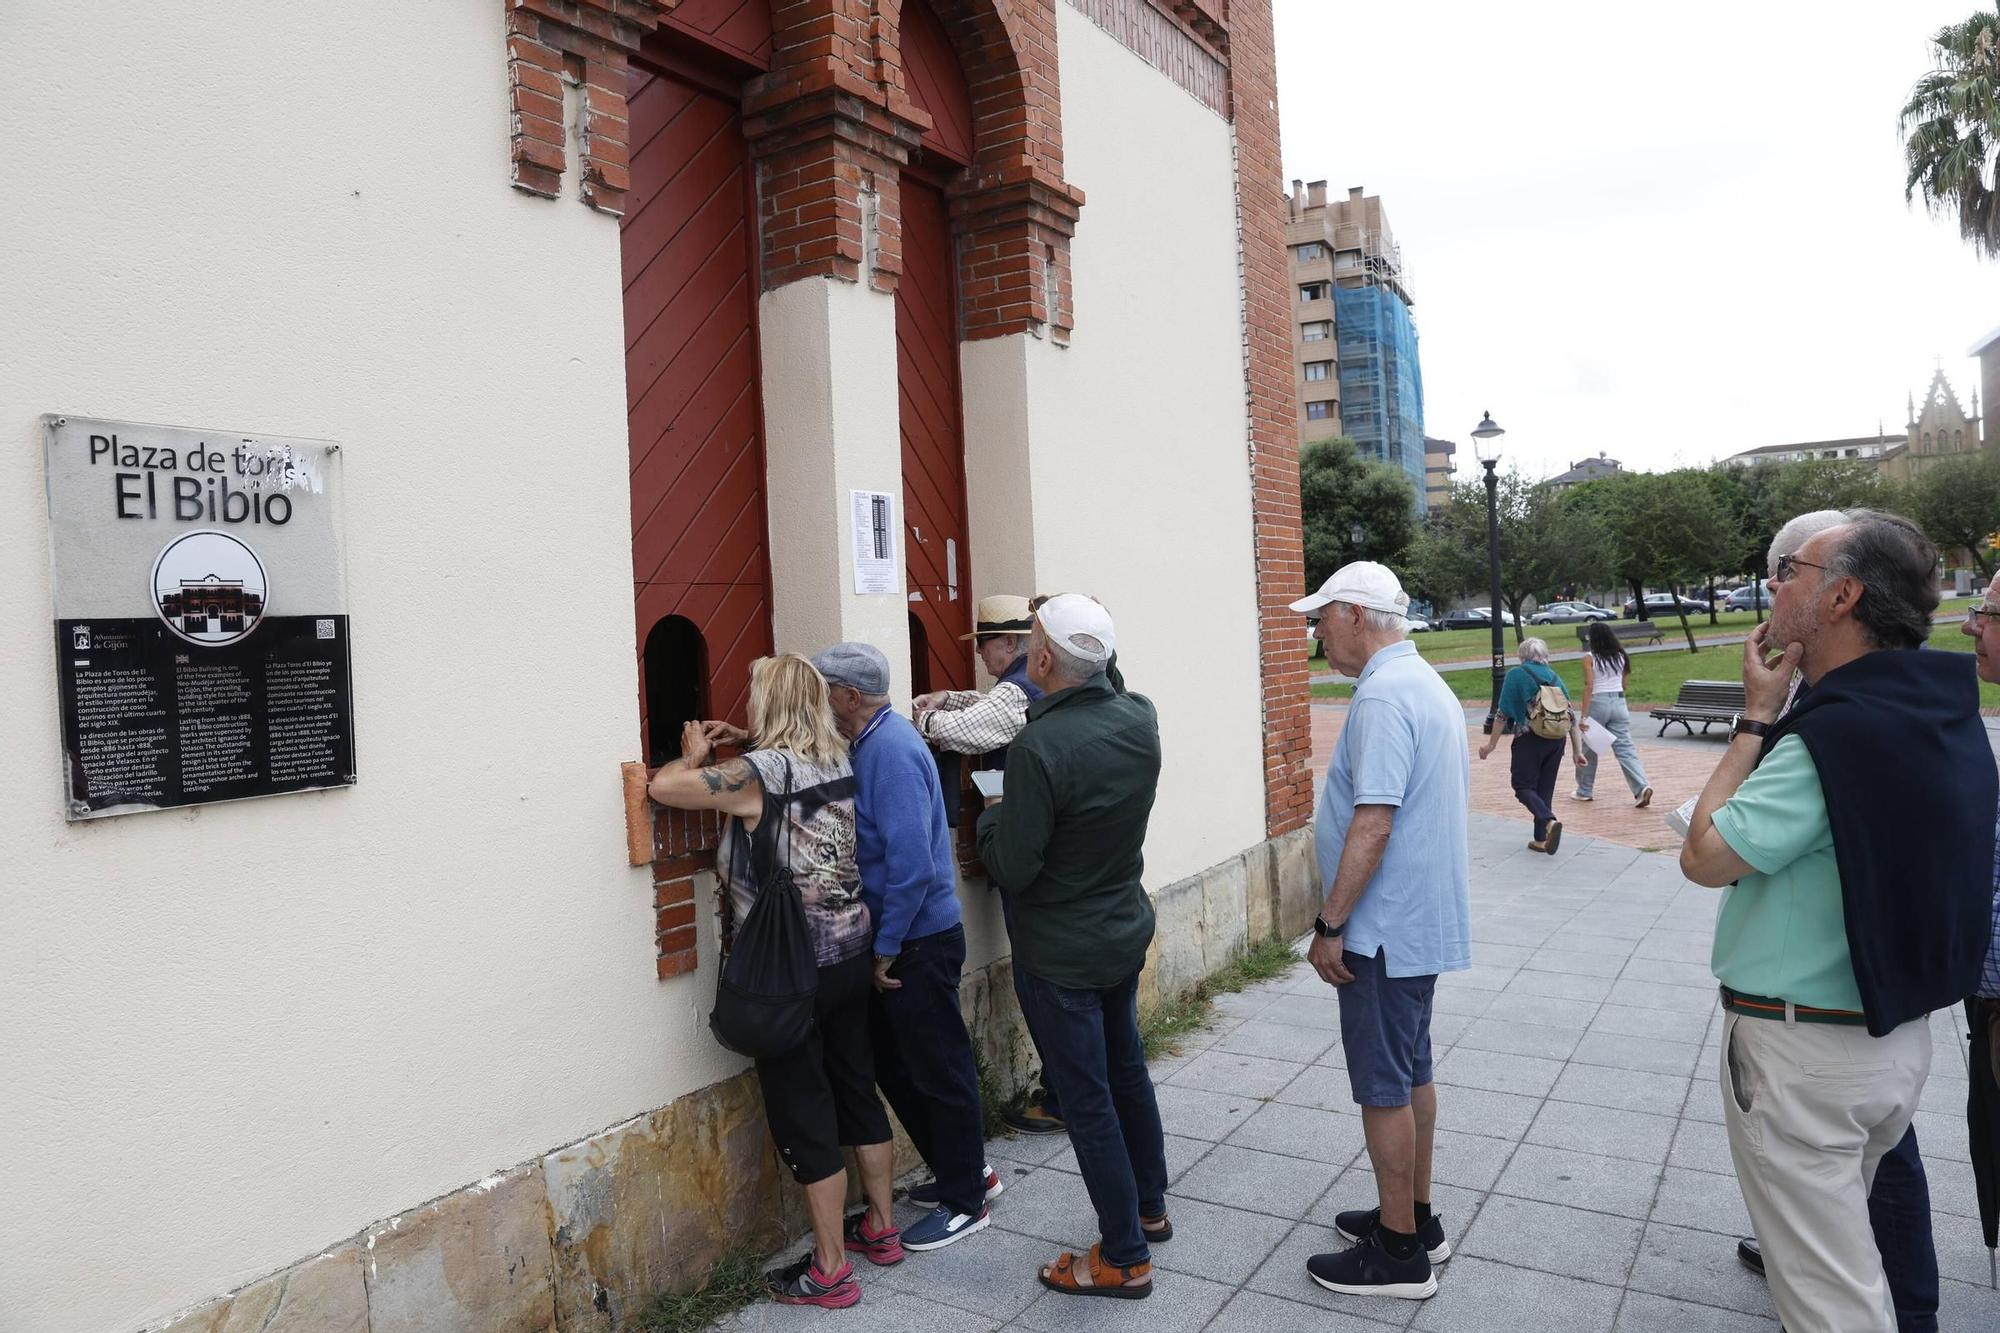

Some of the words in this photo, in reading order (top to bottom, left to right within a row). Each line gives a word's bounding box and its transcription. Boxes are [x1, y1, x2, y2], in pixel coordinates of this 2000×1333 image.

[89, 434, 177, 470] Plaza
[186, 441, 225, 473] de
[115, 471, 157, 519] El
[173, 476, 292, 525] Bibio
[103, 640, 129, 651] Gijón
[76, 685, 107, 693] ejemplos
[77, 692, 118, 700] arquitectura
[104, 698, 138, 706] imperante
[77, 706, 120, 714] construcción
[78, 713, 106, 721] taurinos
[90, 720, 107, 728] siglo
[88, 731, 118, 739] dirección
[128, 734, 167, 744] prolongaron
[137, 748, 169, 757] arquitecto
